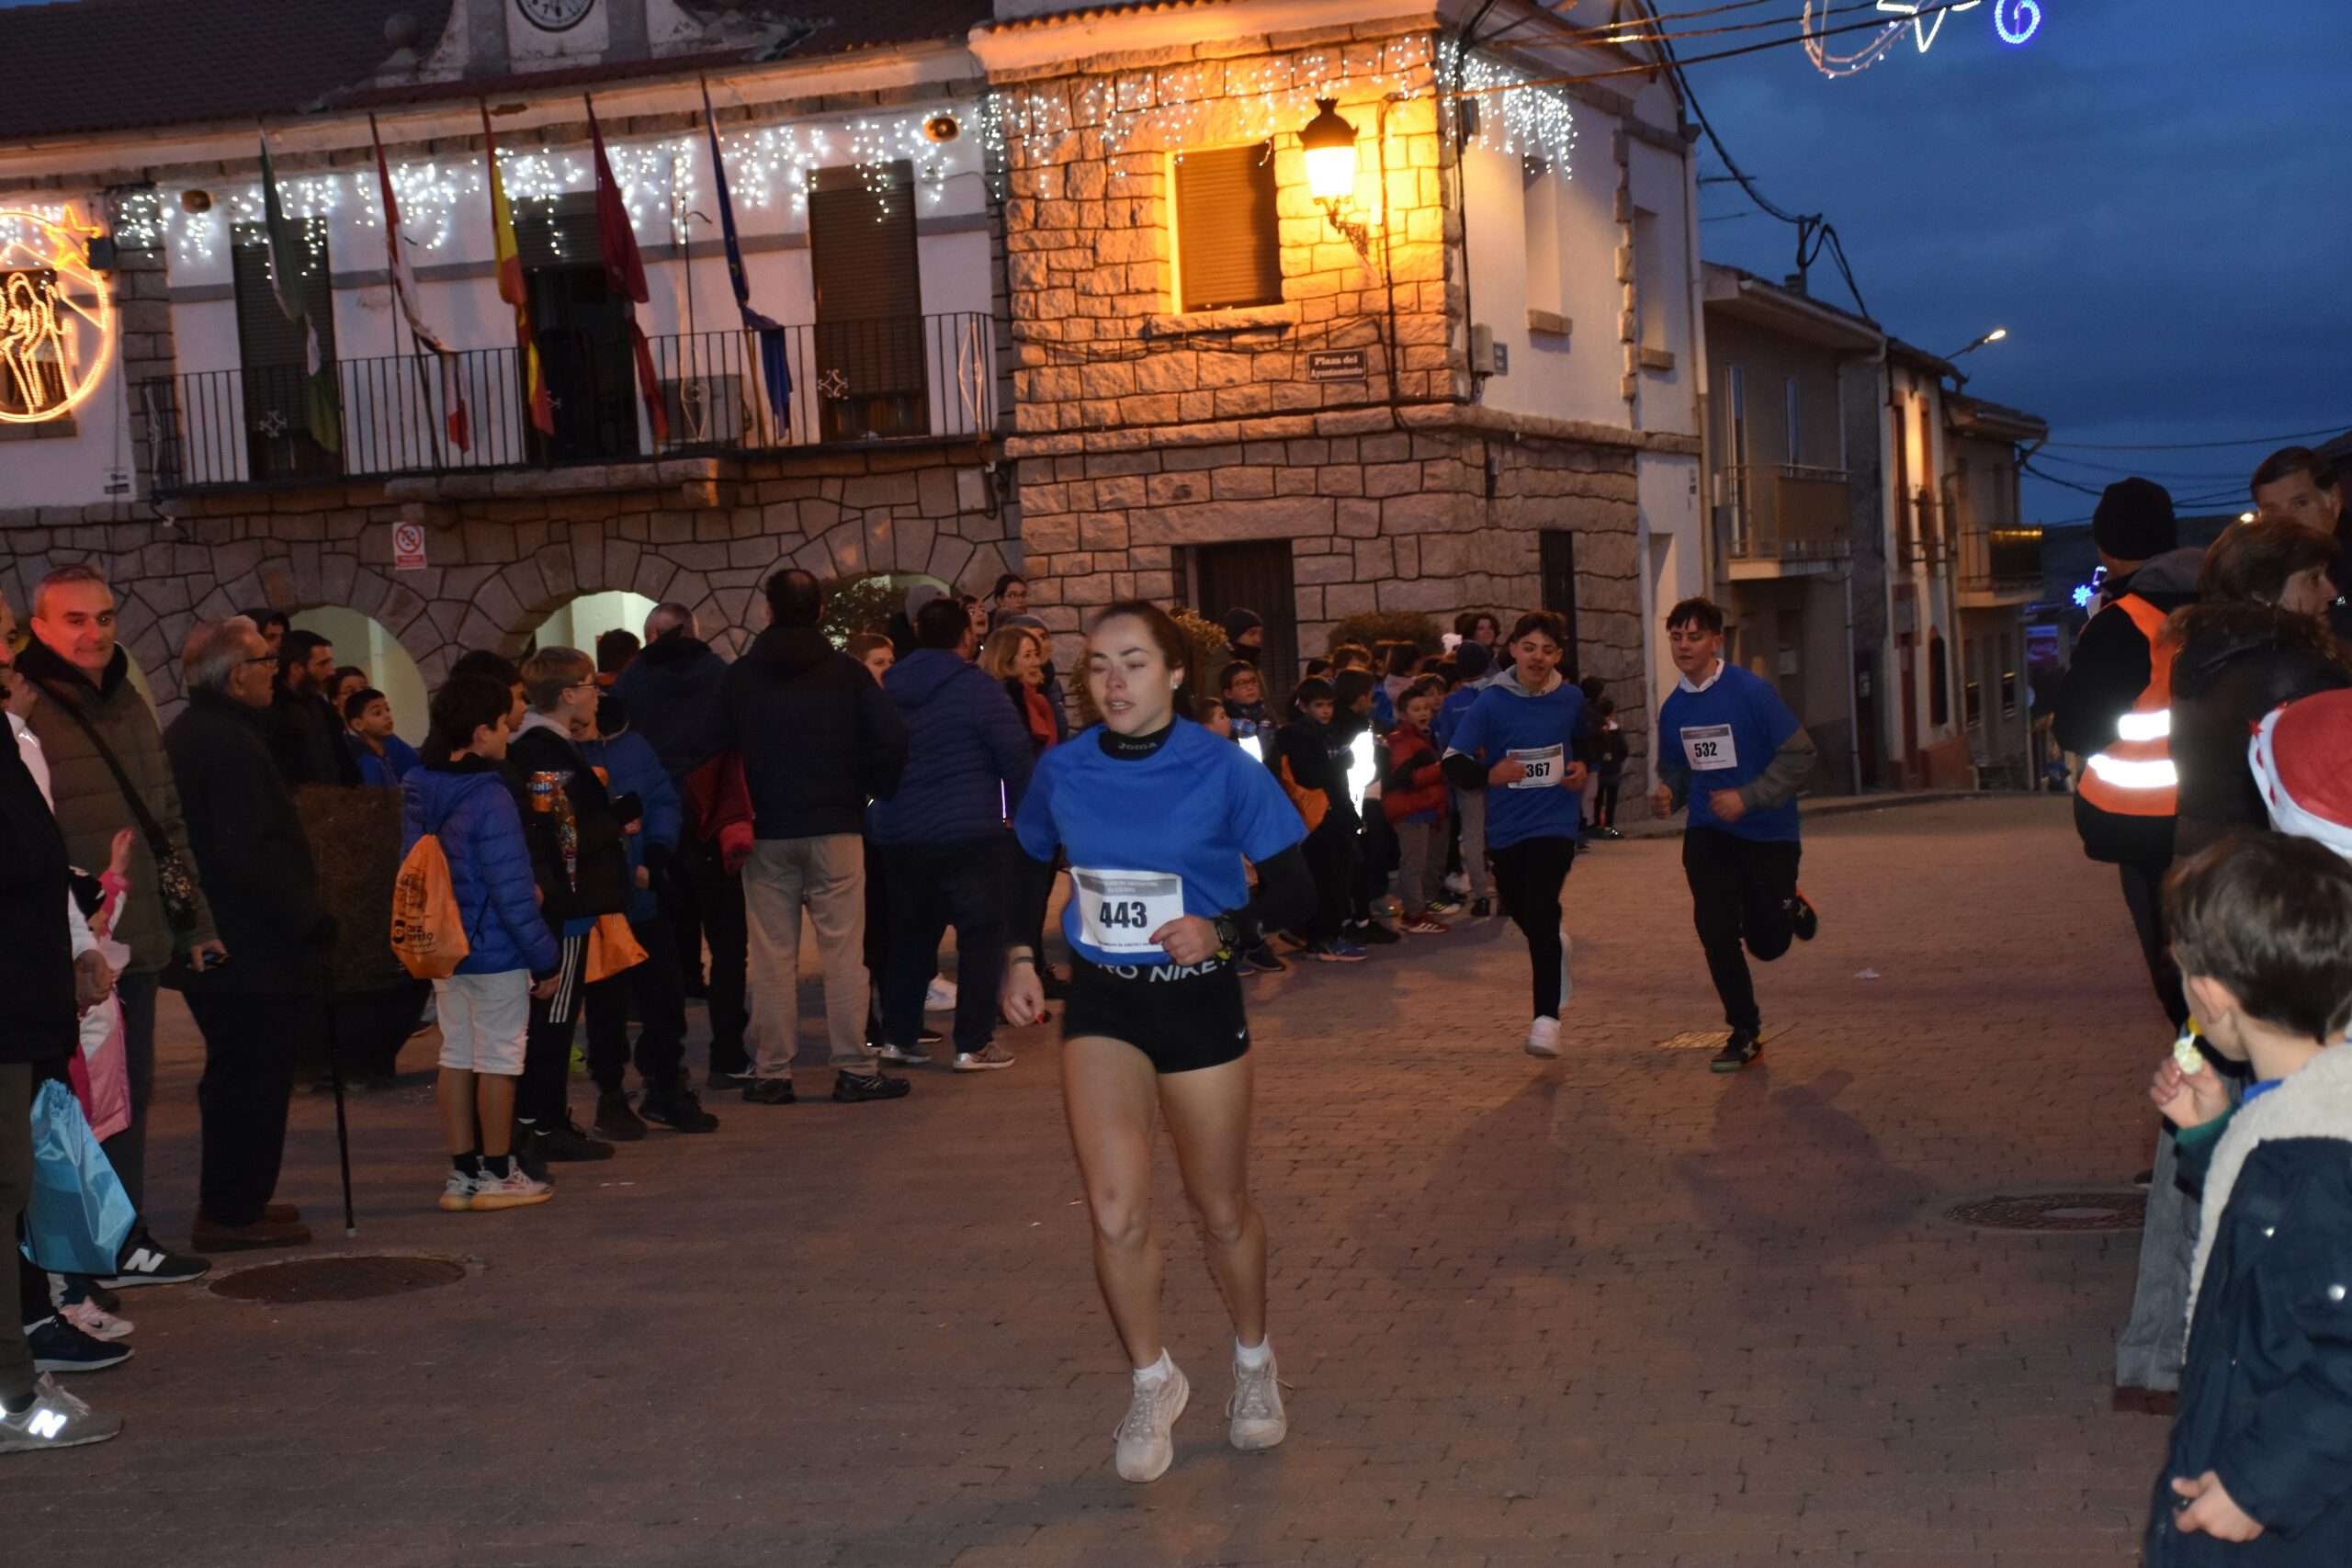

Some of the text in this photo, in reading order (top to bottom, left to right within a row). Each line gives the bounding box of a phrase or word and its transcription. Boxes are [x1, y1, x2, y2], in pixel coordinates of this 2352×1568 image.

[1694, 742, 1718, 758] 532
[1526, 761, 1550, 778] 367
[1100, 901, 1148, 929] 443
[1149, 960, 1218, 983] NIKE
